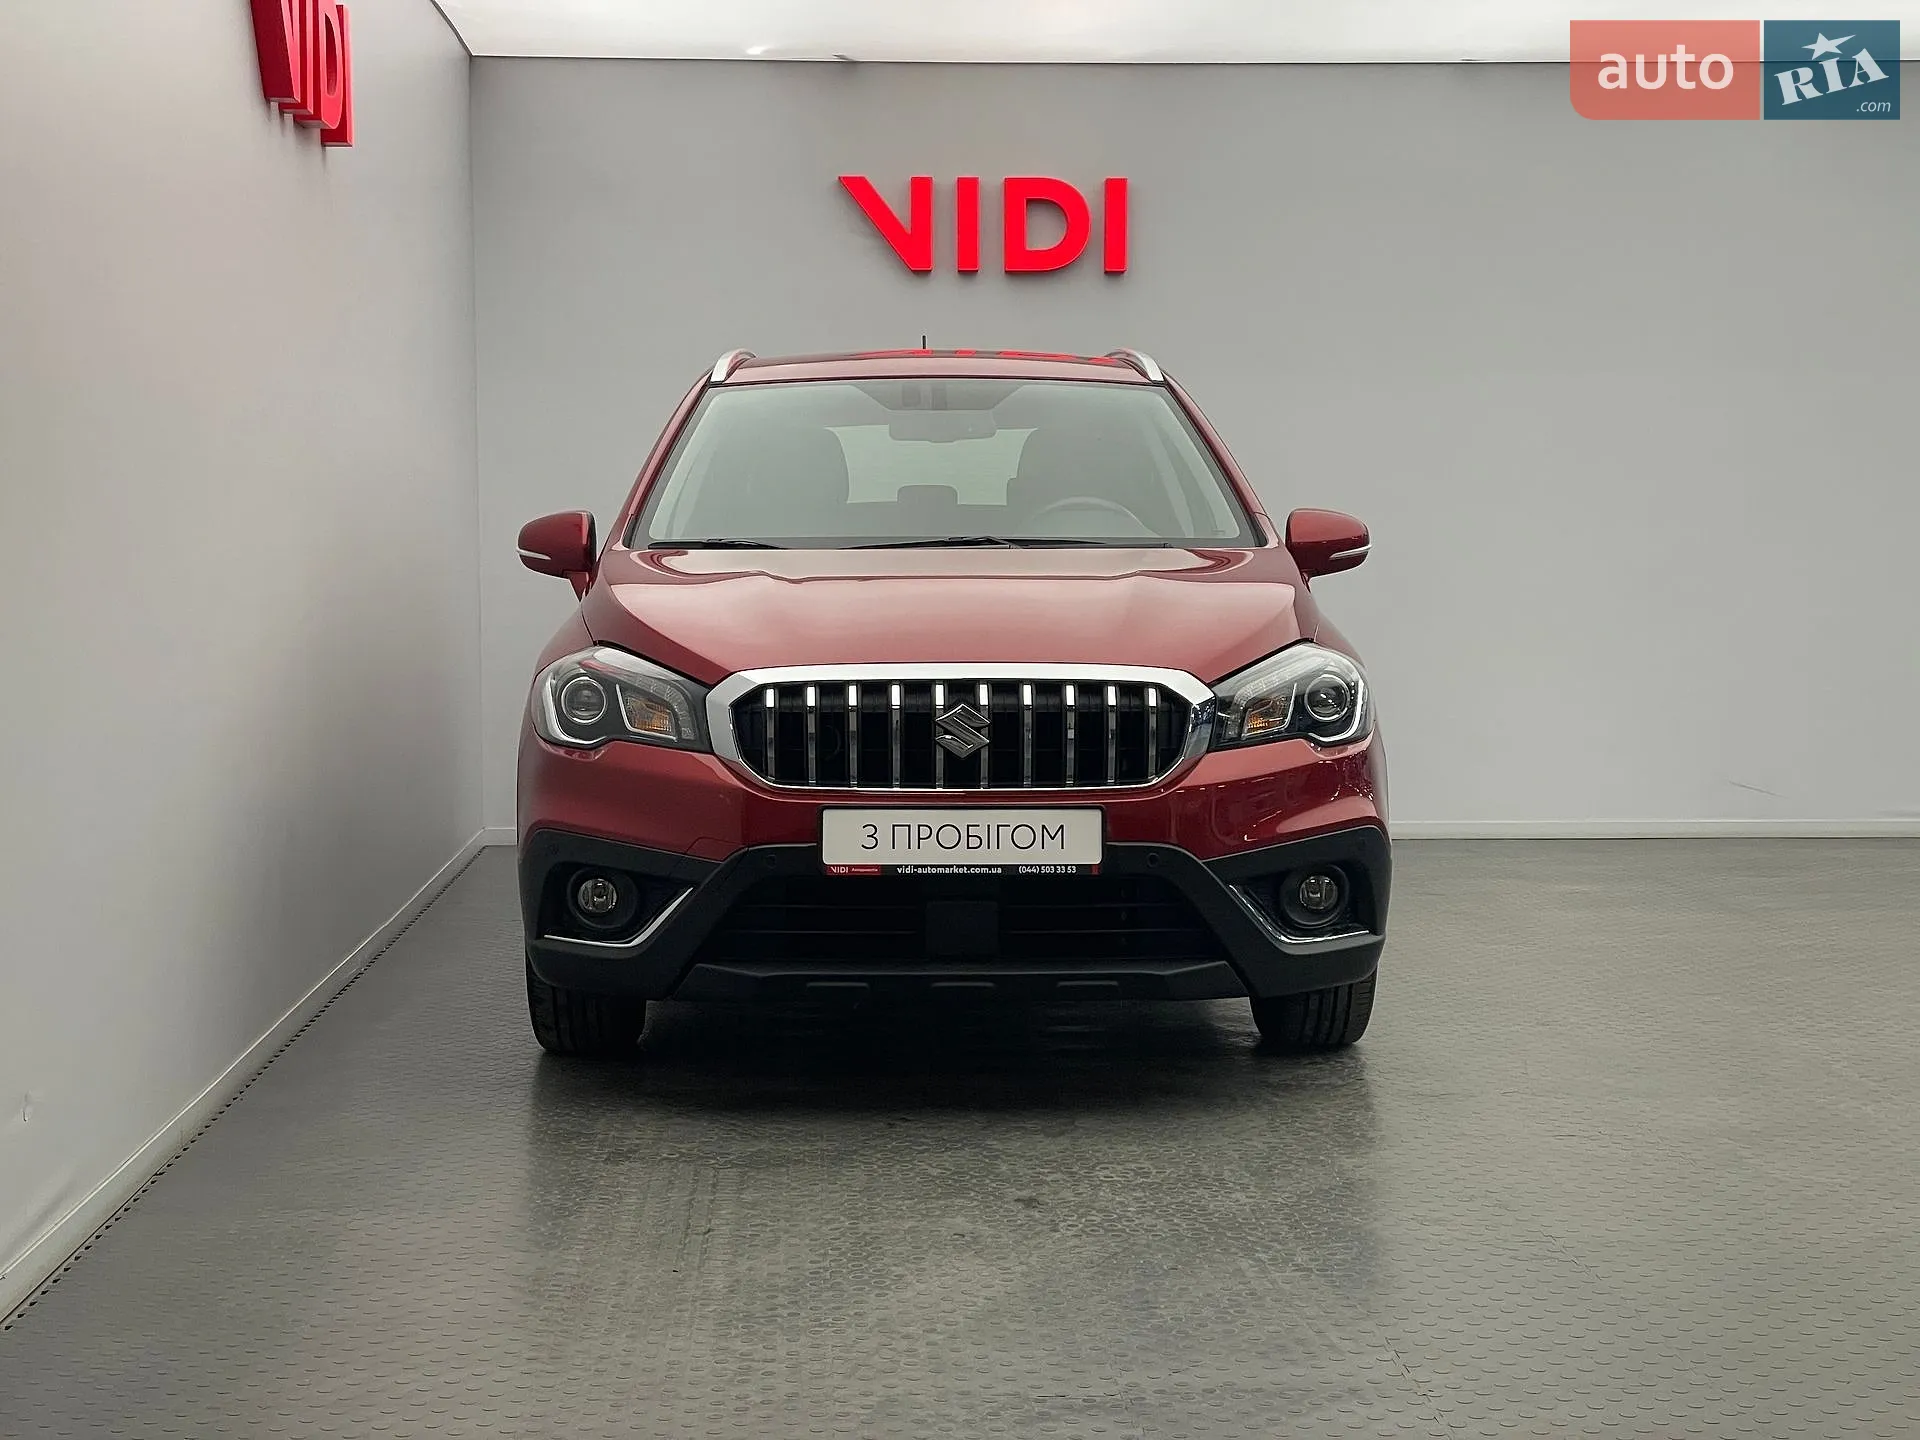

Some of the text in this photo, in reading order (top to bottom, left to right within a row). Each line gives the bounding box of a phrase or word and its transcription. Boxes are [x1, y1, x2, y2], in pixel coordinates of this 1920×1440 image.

[838, 176, 1128, 273] VIDI
[891, 823, 1065, 850] ПРОБІГОМ
[830, 866, 849, 874] VIDI
[896, 865, 1002, 874] vidi-automarket.com.ua
[1018, 865, 1077, 874] (044) 503 33 53
